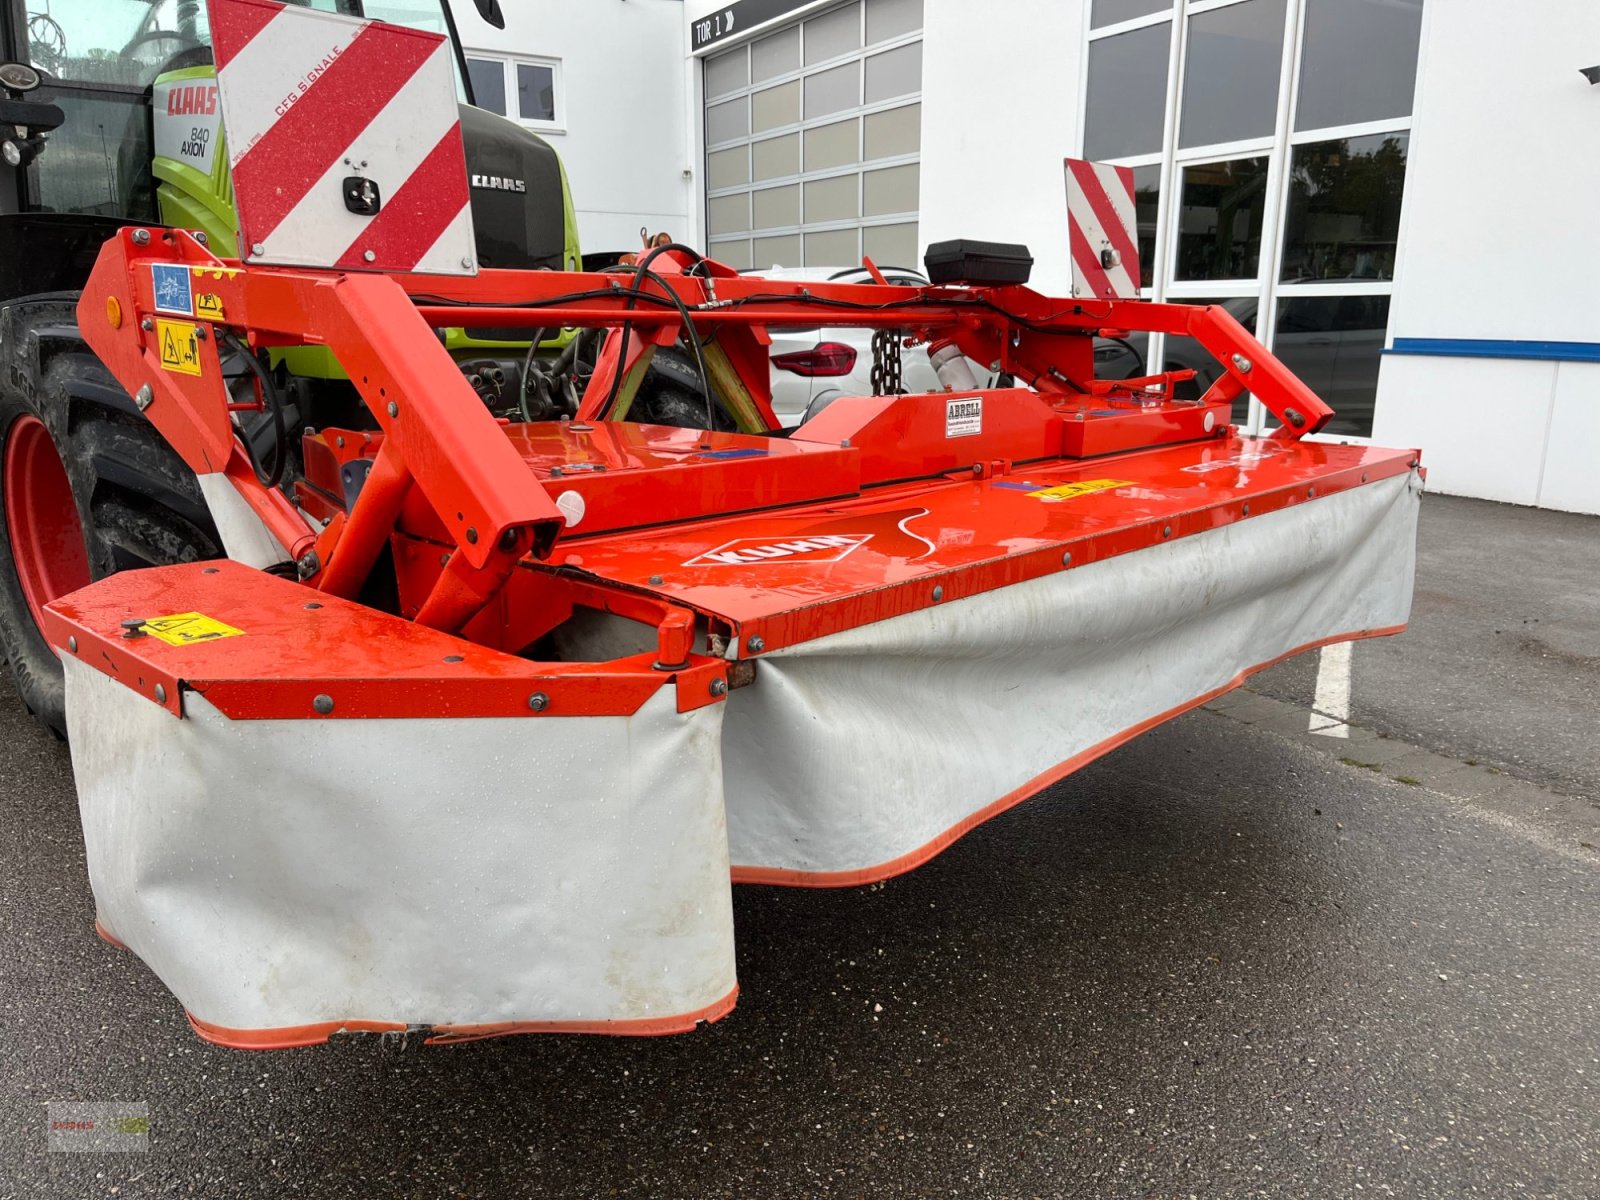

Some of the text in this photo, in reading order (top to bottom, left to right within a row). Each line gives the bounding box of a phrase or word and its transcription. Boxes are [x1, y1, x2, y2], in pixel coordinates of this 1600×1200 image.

[696, 16, 721, 44] TOR 1
[167, 86, 218, 116] CLAAS
[274, 92, 298, 117] CFG
[190, 127, 210, 143] 840
[181, 141, 206, 158] AXION
[472, 174, 526, 192] CLAAS
[948, 402, 980, 419] ABRELL
[701, 535, 862, 564] KUHN
